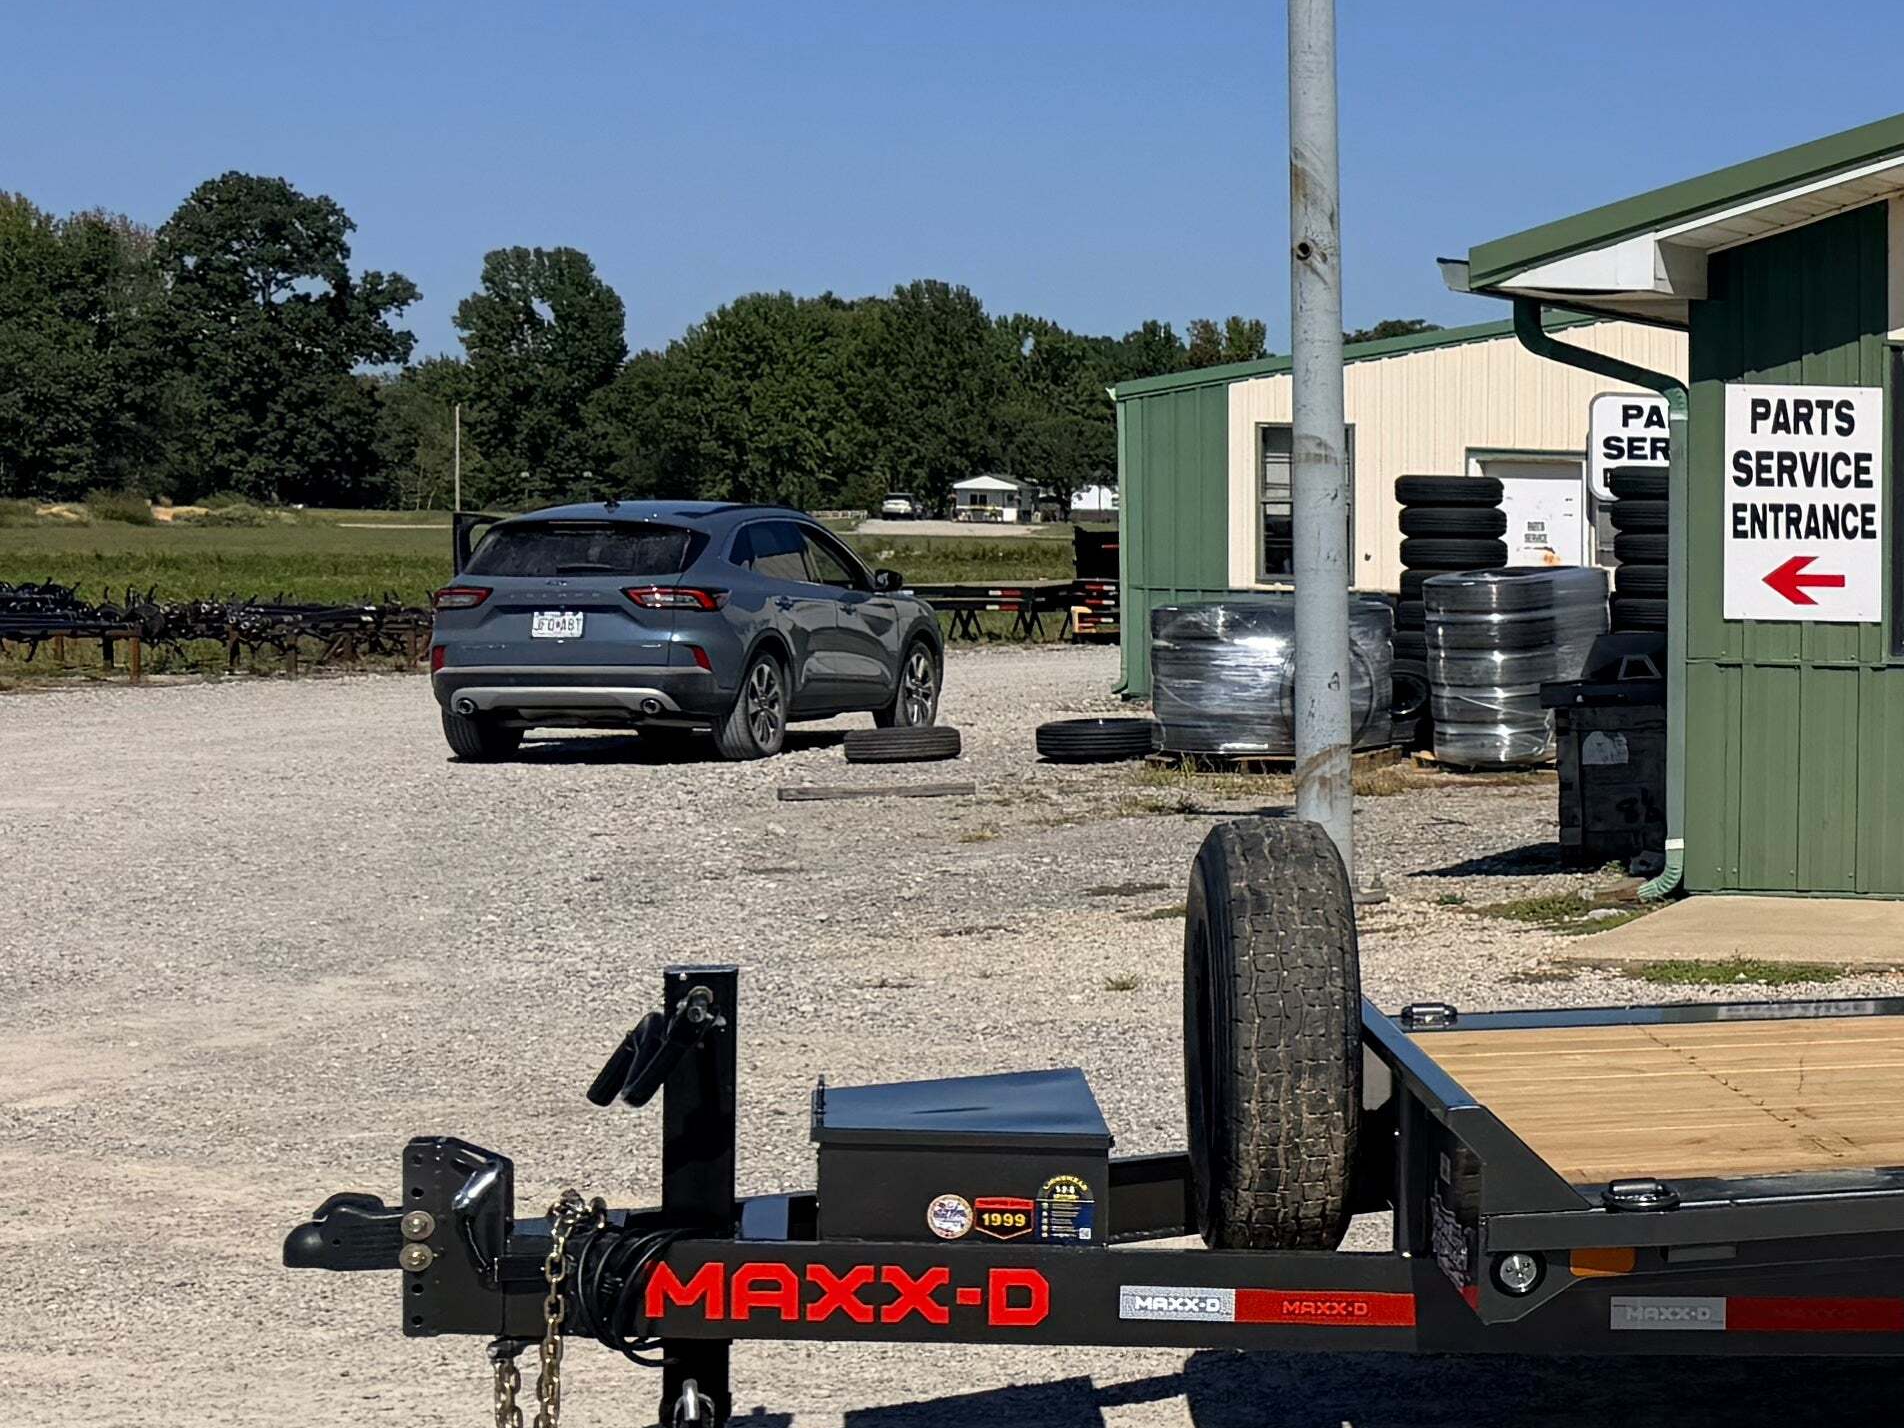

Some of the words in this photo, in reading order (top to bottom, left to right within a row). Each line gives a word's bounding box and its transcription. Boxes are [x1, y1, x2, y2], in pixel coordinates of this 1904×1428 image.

[1750, 397, 1856, 438] PARTS
[1731, 449, 1874, 490] SERVICE
[1731, 502, 1878, 541] ENTRANCE
[981, 1212, 1027, 1228] 1999
[645, 1260, 1050, 1327] MAXX-D
